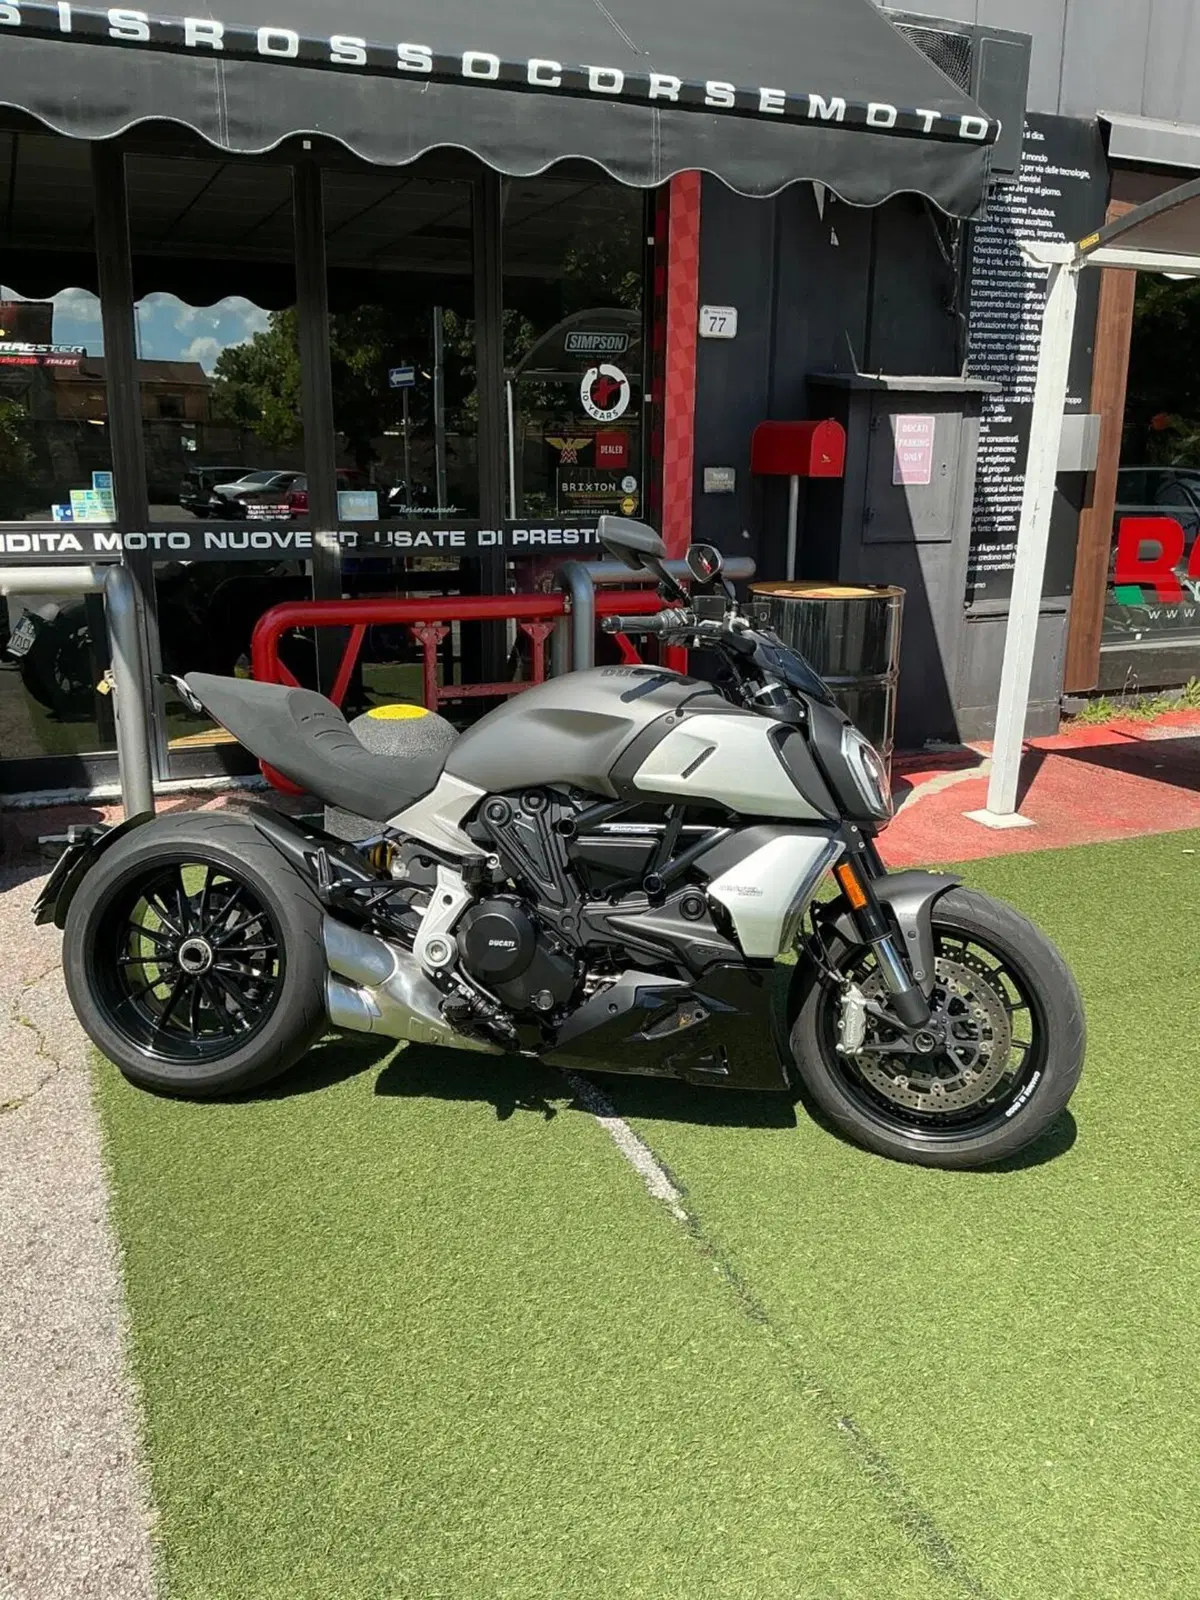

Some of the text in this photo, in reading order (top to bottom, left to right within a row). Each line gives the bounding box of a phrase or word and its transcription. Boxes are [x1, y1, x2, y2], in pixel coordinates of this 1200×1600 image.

[1026, 152, 1048, 162] mondo
[1045, 165, 1059, 175] delle
[1041, 187, 1062, 197] giorno.
[988, 203, 1010, 211] costano
[1010, 206, 1027, 215] come
[973, 245, 1002, 255] Chiedono
[972, 256, 986, 264] Non
[972, 267, 981, 275] Ed
[998, 270, 1020, 278] mercato
[970, 288, 978, 296] La
[978, 290, 1018, 299] competizione
[970, 298, 1004, 309] imponendo
[970, 310, 1008, 320] giornalmente
[710, 316, 726, 332] 77
[1024, 322, 1040, 332] dura,
[569, 335, 624, 350] SIMPSON
[588, 403, 619, 420] YEARS
[902, 424, 929, 433] DUCATI
[600, 445, 624, 455] DEALER
[904, 452, 924, 461] ONLY
[562, 482, 616, 492] BRIXTON
[0, 533, 83, 552] DITA
[93, 531, 191, 551] MOTO
[204, 531, 313, 550] NUOVE
[374, 530, 466, 548] USATE
[477, 530, 503, 546] DI
[488, 939, 516, 948] DUCATI
